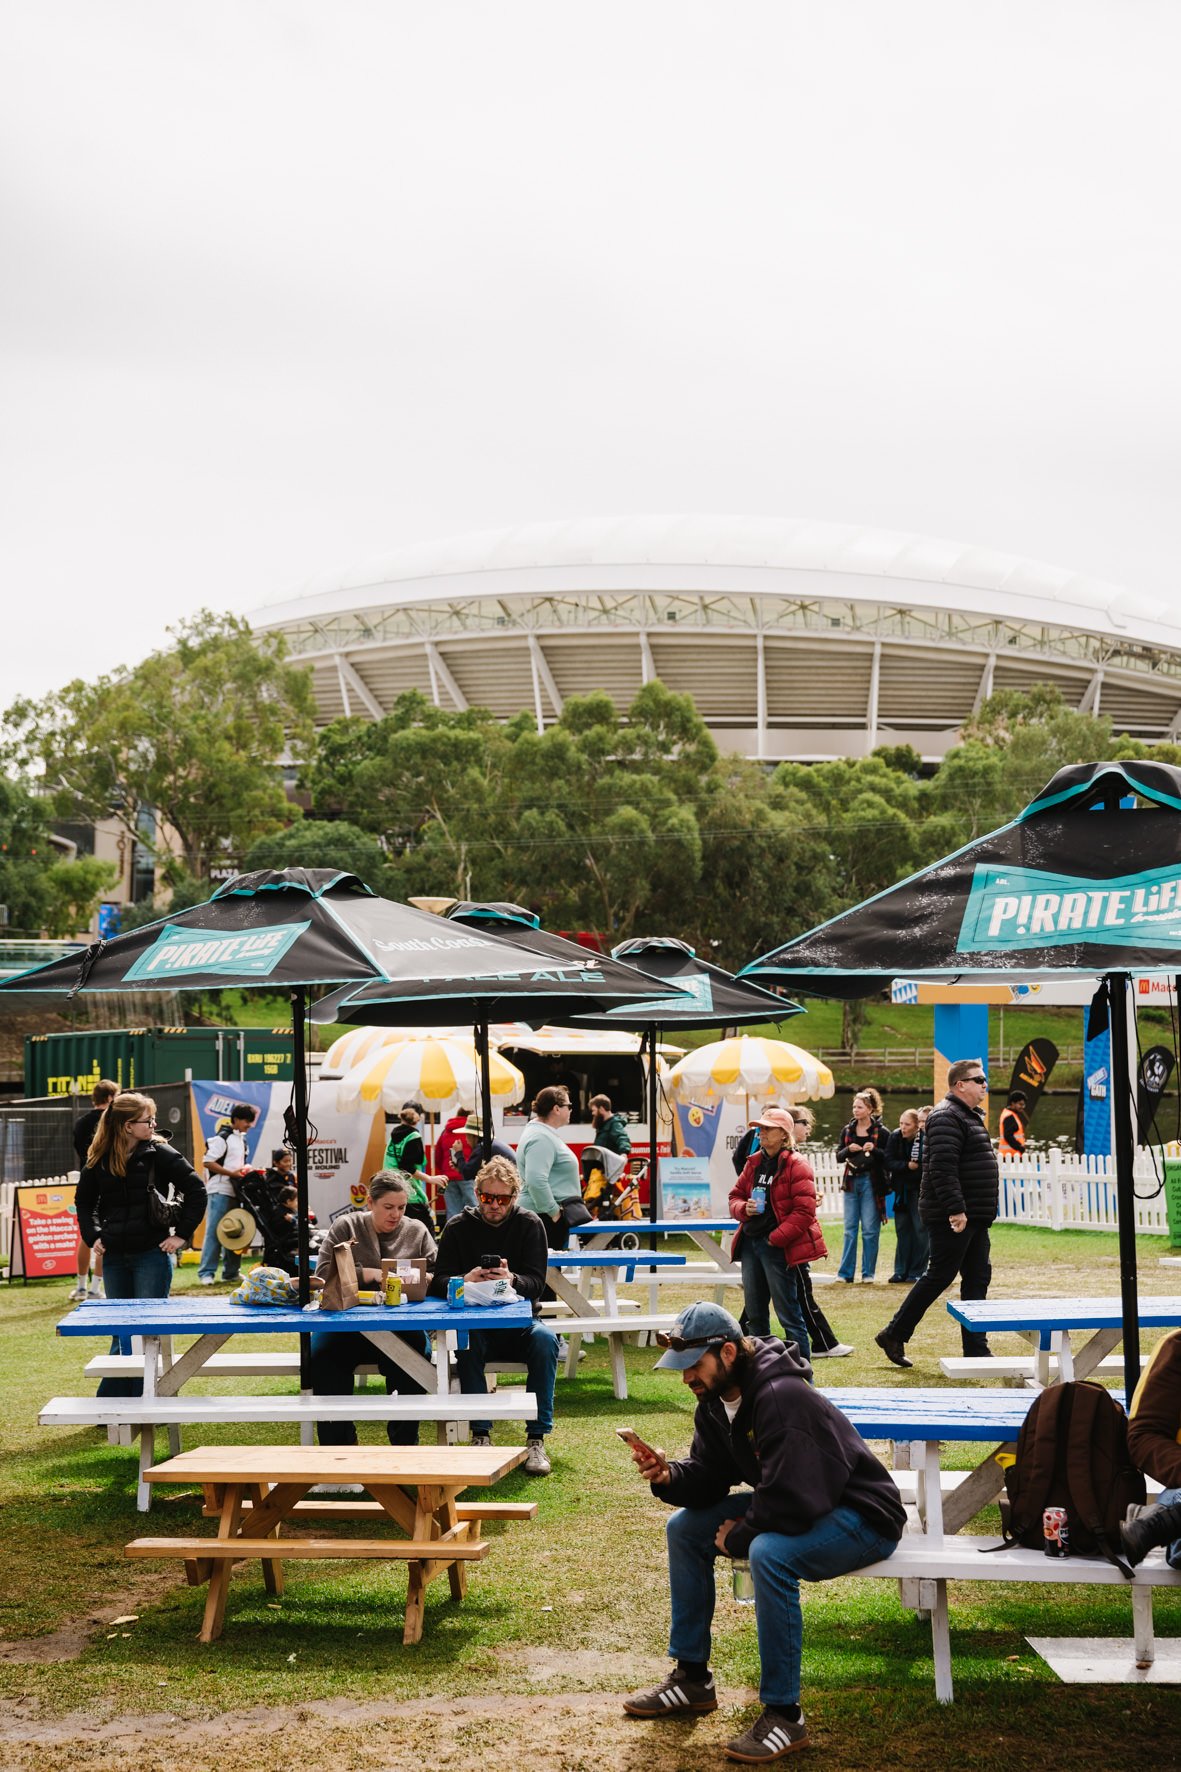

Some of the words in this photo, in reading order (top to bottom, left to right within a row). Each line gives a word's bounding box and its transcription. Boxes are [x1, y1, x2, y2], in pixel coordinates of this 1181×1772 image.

[372, 938, 433, 952] South
[1151, 981, 1177, 993] Macc
[208, 1097, 236, 1115] ADEL
[307, 1147, 349, 1165] FESTIVAL
[28, 1218, 46, 1226] Take
[52, 1216, 74, 1226] swing
[36, 1226, 49, 1234] the
[28, 1234, 53, 1244] golden
[53, 1232, 78, 1240] arches
[32, 1242, 50, 1250] with
